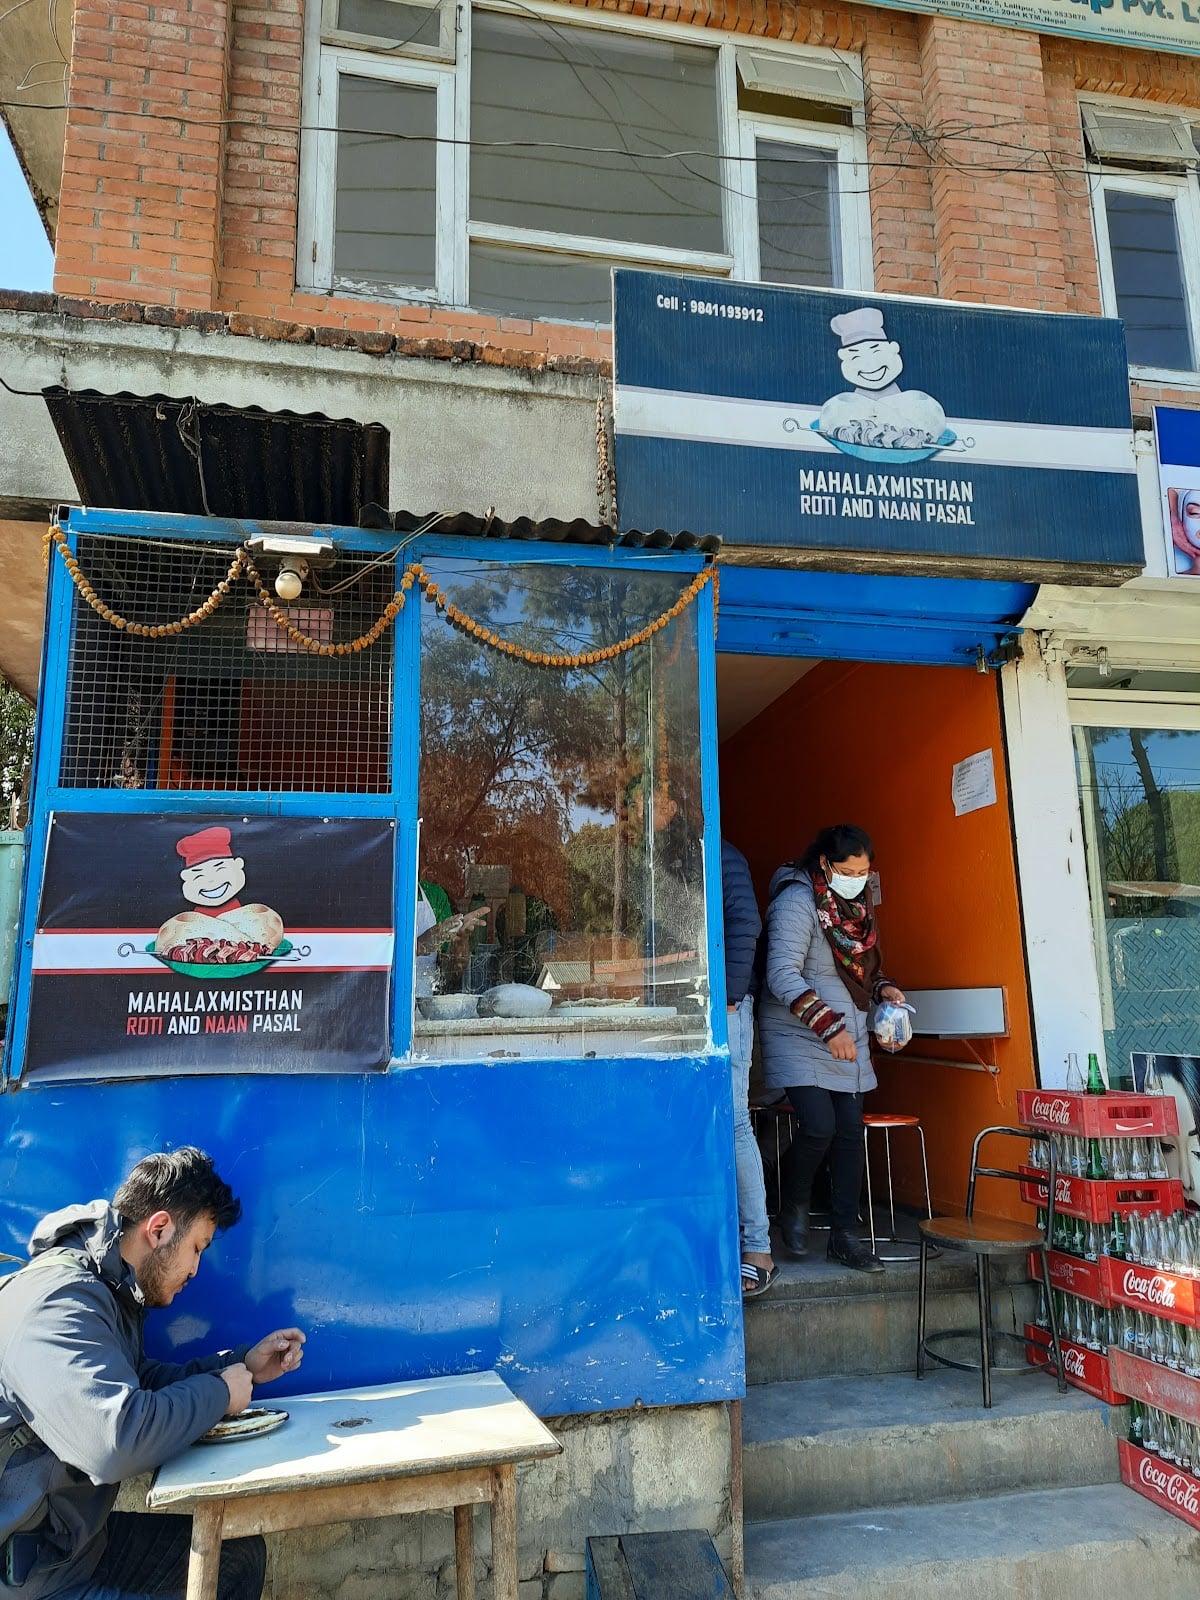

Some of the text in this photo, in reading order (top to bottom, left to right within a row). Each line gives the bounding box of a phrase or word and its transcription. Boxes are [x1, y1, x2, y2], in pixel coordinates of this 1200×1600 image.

[1181, 1, 1200, 23] L
[656, 294, 679, 311] Cell
[690, 299, 764, 322] 9841193912
[799, 469, 974, 503] MAHALAXMISTHAN
[800, 495, 976, 526] ROTI AND NAAN PASAL
[127, 989, 303, 1013] MAHALAXMISTHAN
[125, 1013, 302, 1036] ROTI AND NAAN PASAL
[1032, 1095, 1070, 1125] Coca-Cola
[1123, 1268, 1176, 1307] Coca-Cola
[1139, 1457, 1200, 1514] Coca-Cola
